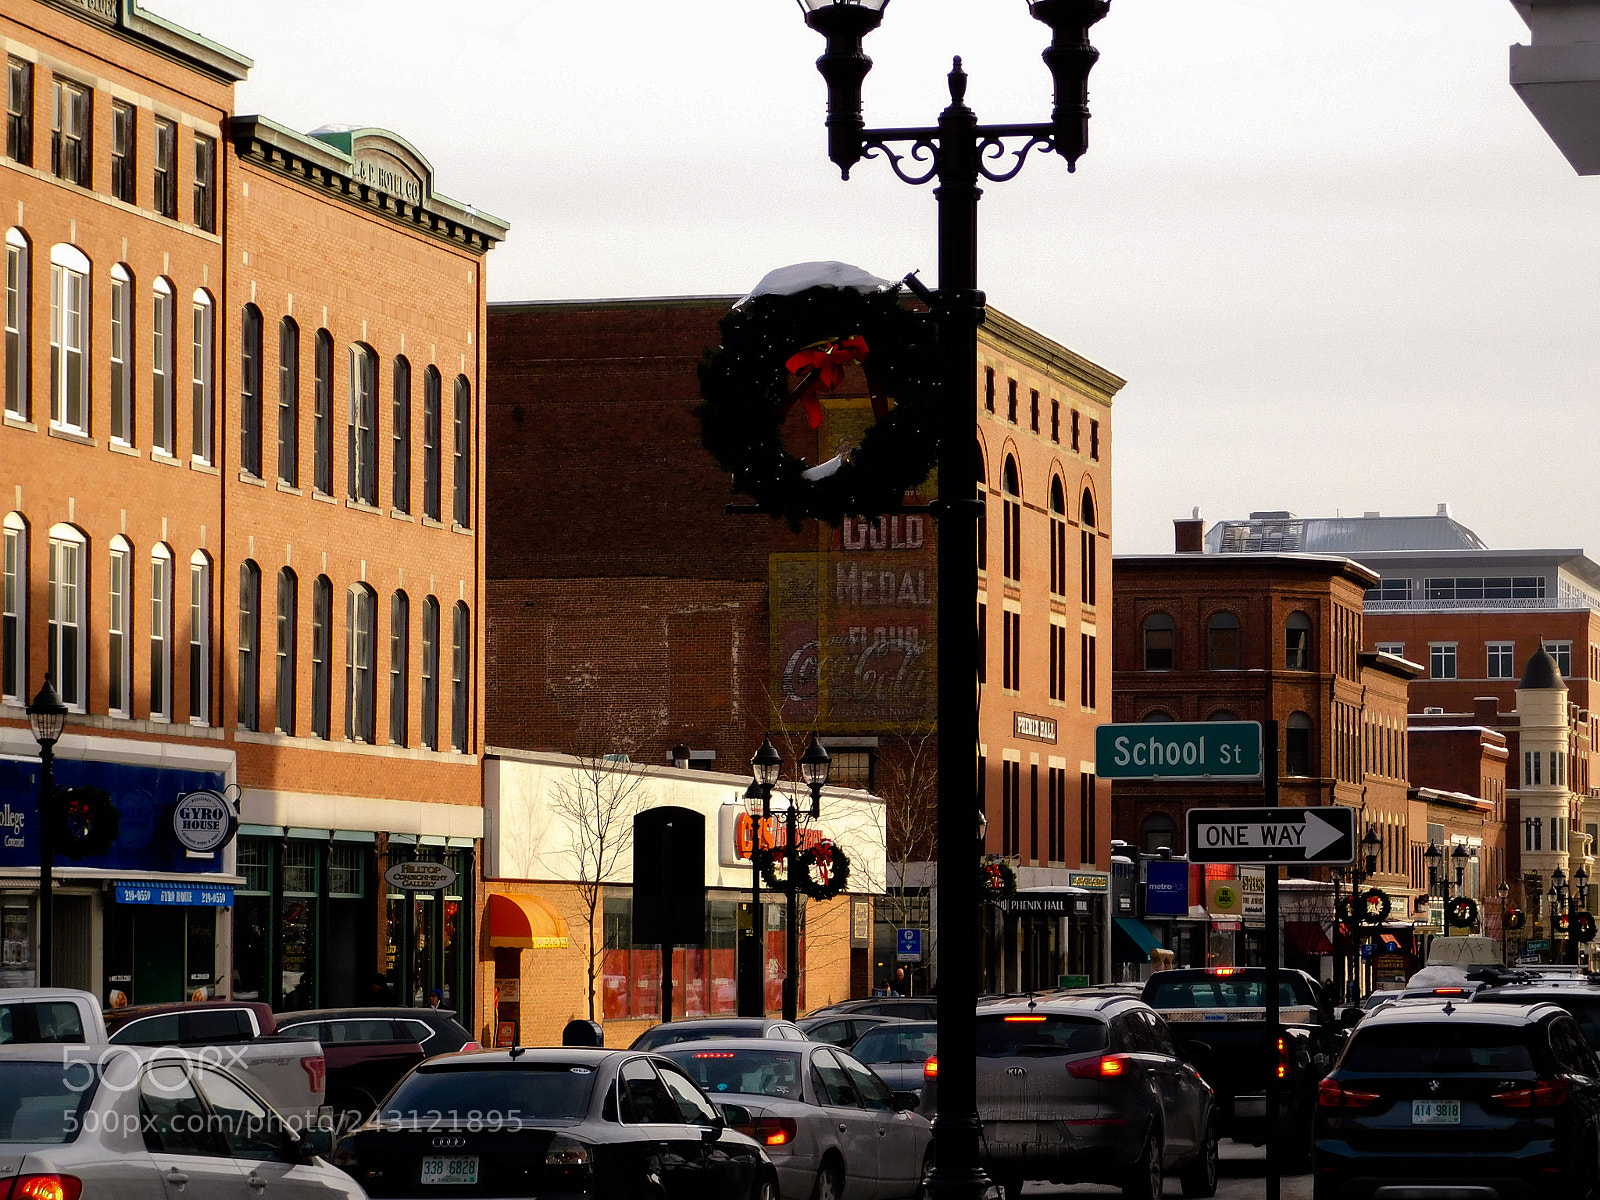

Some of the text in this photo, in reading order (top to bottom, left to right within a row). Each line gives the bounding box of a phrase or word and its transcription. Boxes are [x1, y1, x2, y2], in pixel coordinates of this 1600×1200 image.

[378, 167, 404, 196] HOTEL
[843, 514, 924, 550] GOLD
[836, 560, 933, 606] MEDAL
[1114, 735, 1243, 766] School St
[179, 807, 224, 820] GYRO
[182, 820, 220, 830] HOUSE
[735, 811, 773, 860] CS
[1206, 825, 1305, 846] ONE WAY
[401, 864, 442, 874] HILLTOP
[393, 873, 448, 881] CONSIGNMENT
[1011, 900, 1043, 911] PHENIX
[1043, 900, 1064, 911] HALL
[1008, 1067, 1024, 1077] KIA
[1497, 1081, 1517, 1089] X1
[1414, 1104, 1459, 1117] 414 9818
[424, 1161, 476, 1175] 338 6828
